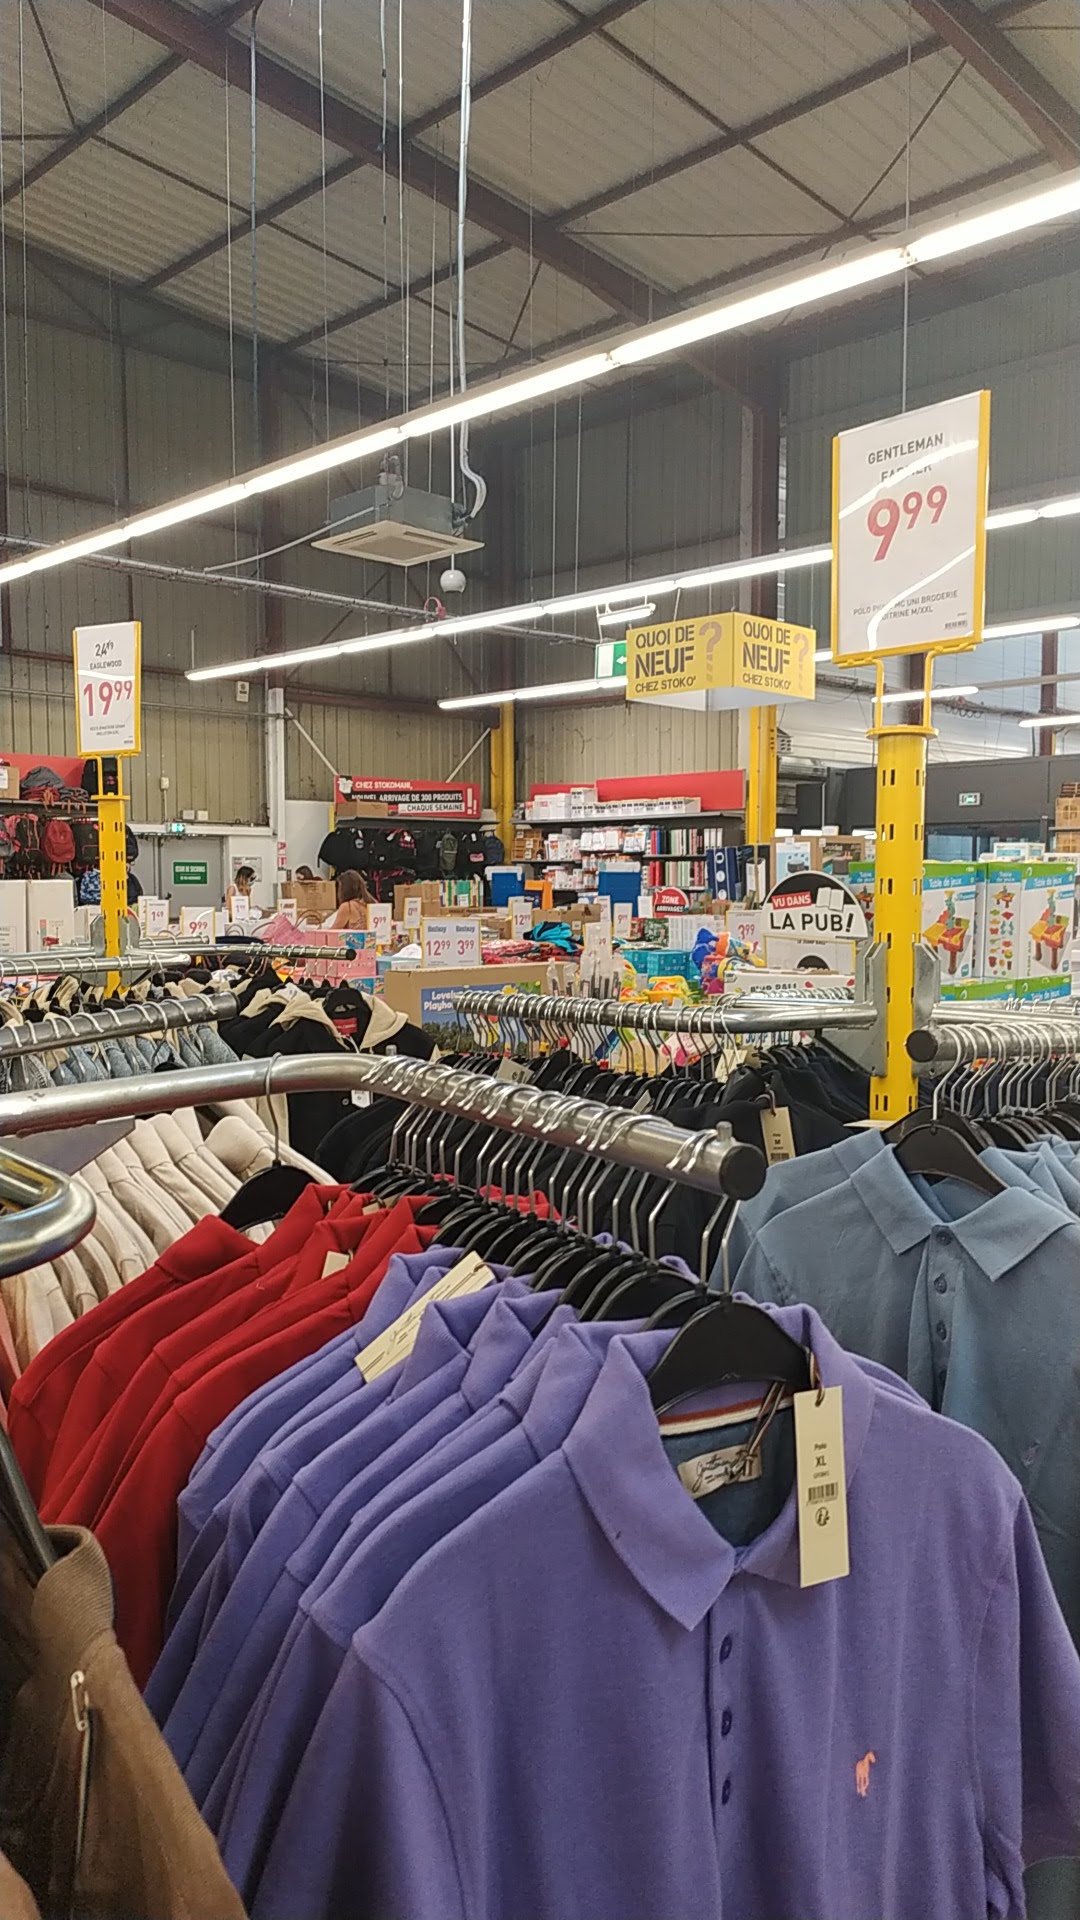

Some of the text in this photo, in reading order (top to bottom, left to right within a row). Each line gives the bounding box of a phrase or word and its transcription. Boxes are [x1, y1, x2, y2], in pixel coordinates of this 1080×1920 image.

[868, 433, 943, 464] GENTLEMAN
[636, 624, 695, 649] QUOI DE
[743, 620, 791, 646] QUOI DE
[635, 645, 695, 679] NEUF
[742, 642, 791, 675] NEUF
[742, 672, 763, 684] CHEZ
[635, 681, 659, 694] CHEZ
[355, 781, 373, 789] CHEZ
[379, 793, 410, 801] ARRIVAGE
[411, 793, 420, 801] DE
[432, 793, 463, 801] PRODUITS
[407, 804, 433, 812] CHAQUE
[434, 803, 463, 811] SEMAINE
[929, 879, 943, 888] Table
[943, 878, 950, 887] de
[661, 896, 680, 905] ZONE
[773, 895, 811, 907] VU DANS
[656, 905, 684, 913] ARRIVAGES
[770, 912, 795, 931] LA
[815, 1455, 827, 1468] XL
